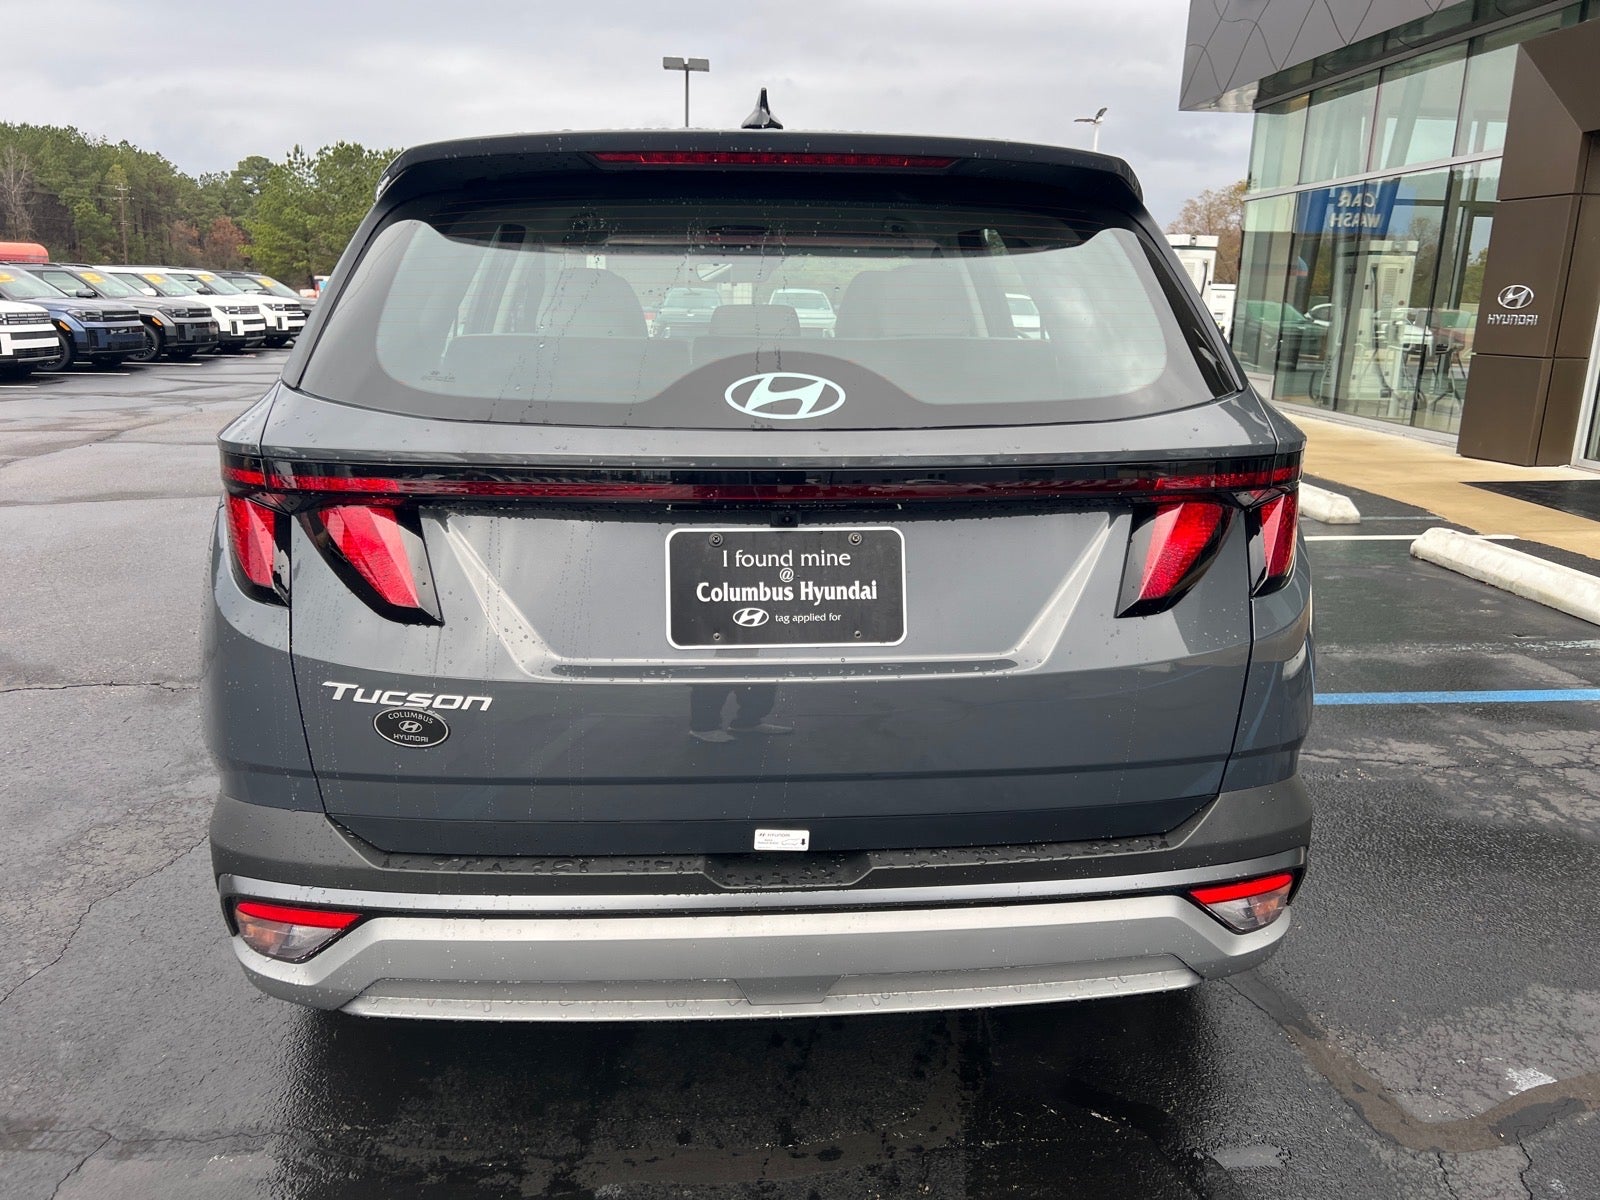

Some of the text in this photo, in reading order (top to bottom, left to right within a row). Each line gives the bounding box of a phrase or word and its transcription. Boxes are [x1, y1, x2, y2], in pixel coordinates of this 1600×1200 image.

[1487, 313, 1539, 326] HYUNDAI
[722, 549, 851, 567] I found mine
[779, 567, 794, 582] @
[696, 580, 877, 605] Columbus Hyundai
[775, 612, 841, 624] tag applied for
[387, 710, 435, 725] COLUMBUS
[393, 733, 429, 743] HYUNDAI
